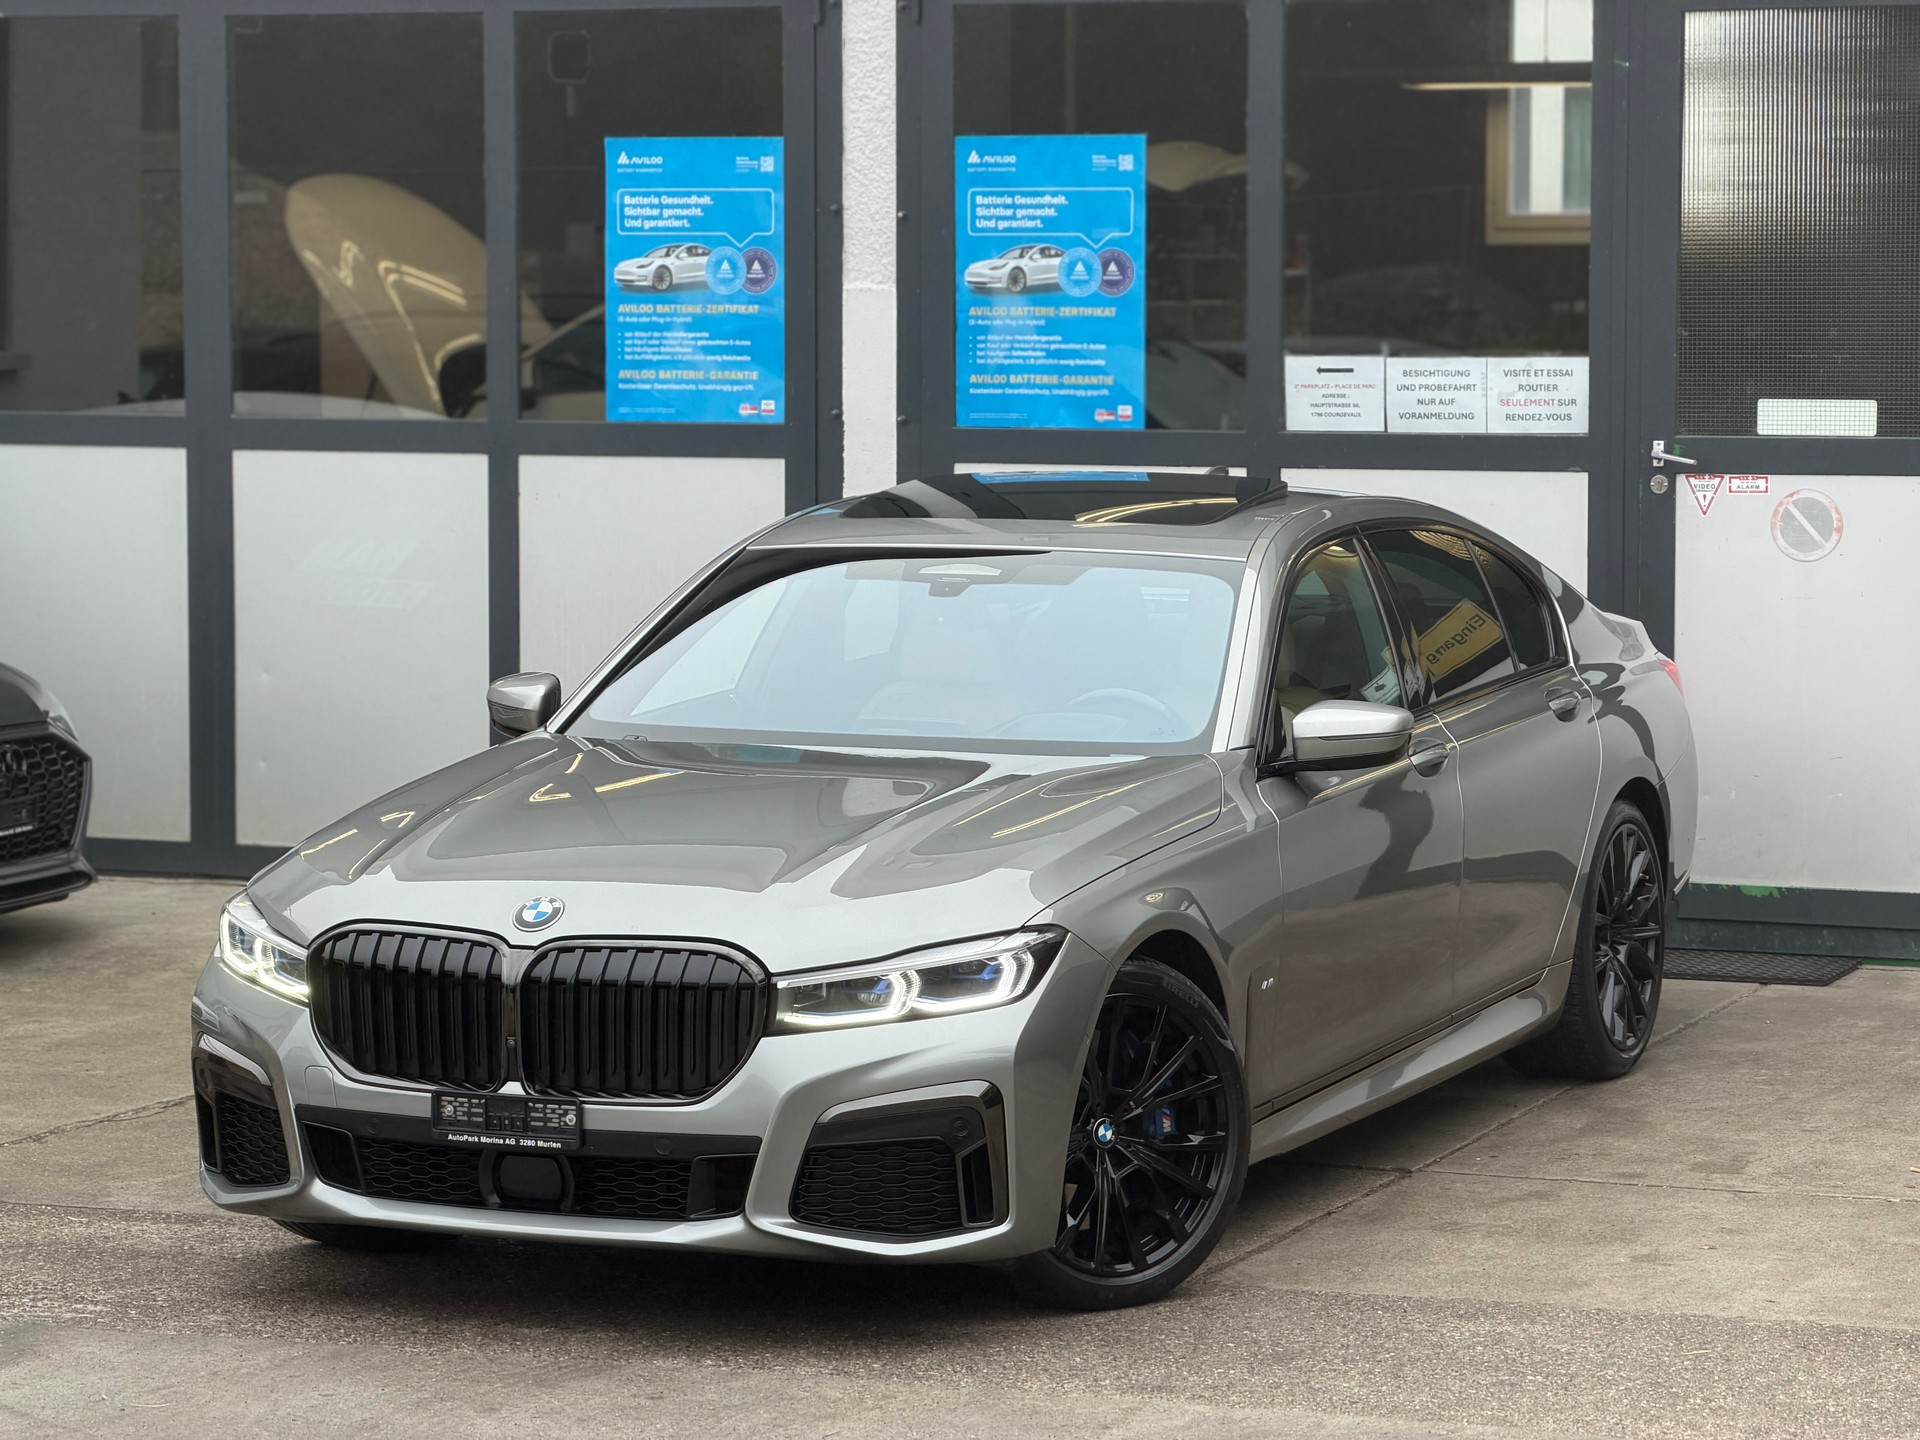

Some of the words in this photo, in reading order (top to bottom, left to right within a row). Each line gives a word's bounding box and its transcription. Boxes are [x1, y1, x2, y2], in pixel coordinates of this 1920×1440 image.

[631, 156, 662, 164] AVILOO
[982, 155, 1016, 163] AVILOO
[624, 195, 659, 204] Batterie
[661, 195, 713, 204] Gesundheit.
[976, 195, 1012, 204] Batterie
[1014, 195, 1068, 204] Gesundheit.
[624, 207, 660, 215] Sichtbar
[663, 207, 704, 218] gemacht.
[976, 207, 1013, 216] Sichtbar
[1016, 207, 1058, 218] gemacht.
[624, 218, 642, 227] Und
[644, 218, 690, 229] garantiert.
[976, 218, 995, 228] Und
[997, 218, 1044, 230] garantiert.
[619, 304, 654, 313] AVILOO
[969, 307, 1007, 316] AVILOO
[619, 370, 655, 379] AVILOO
[1503, 369, 1532, 377] VISITE
[1534, 369, 1544, 377] ET
[1547, 369, 1573, 377] ESSAI
[970, 374, 1007, 384] AVILOO
[1518, 384, 1558, 392] ROUTIER
[1417, 398, 1436, 406] NUR
[1438, 398, 1456, 406] AUF
[1398, 412, 1474, 420] VORANMELDUNG
[1505, 413, 1572, 421] RENDEZ-VOUS
[448, 1134, 479, 1142] AutoPark
[481, 1136, 504, 1144] Morina
[537, 1140, 561, 1148] Murten
